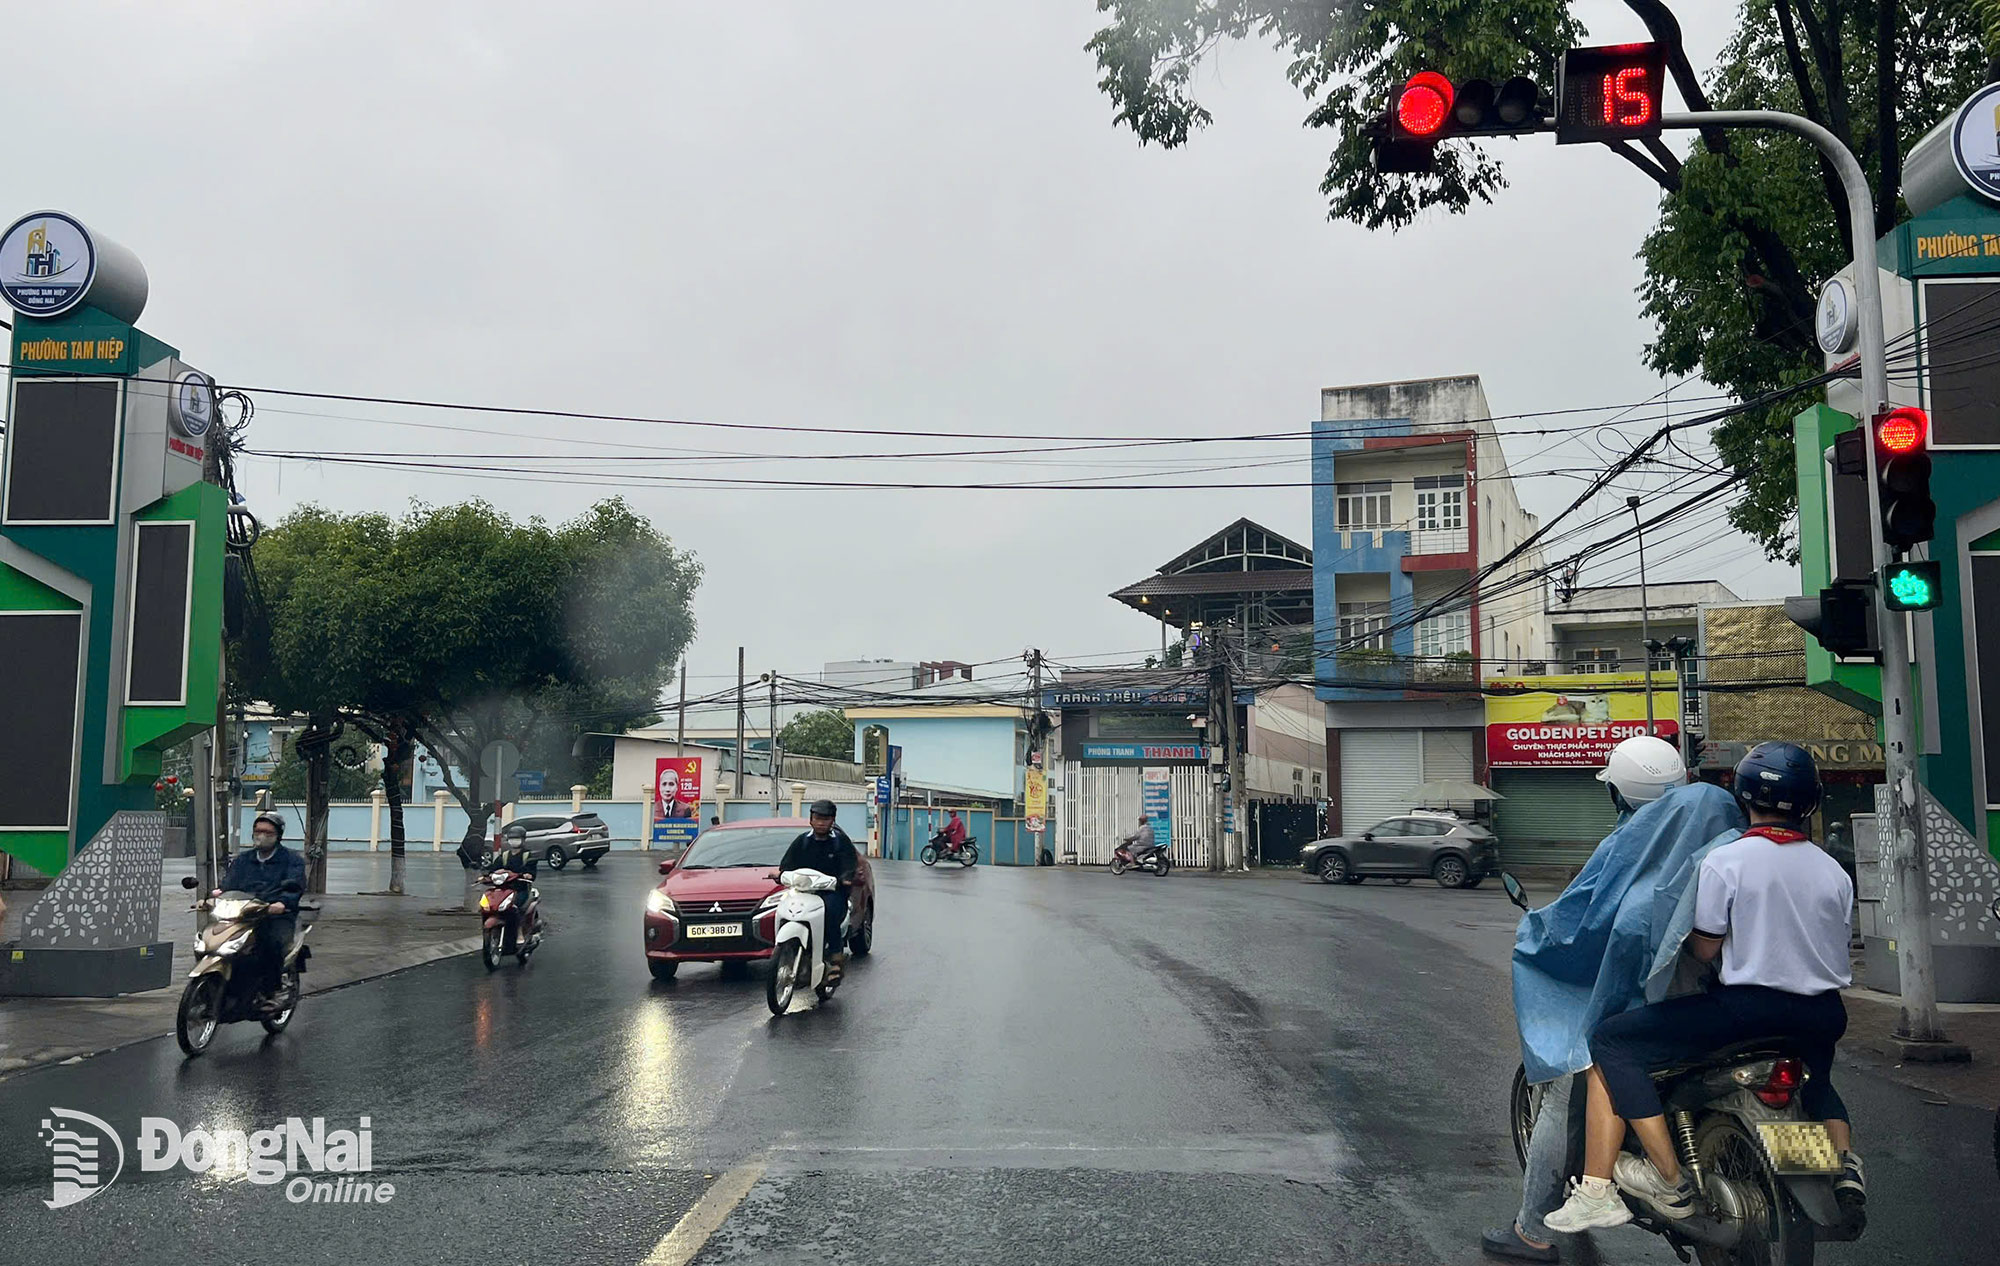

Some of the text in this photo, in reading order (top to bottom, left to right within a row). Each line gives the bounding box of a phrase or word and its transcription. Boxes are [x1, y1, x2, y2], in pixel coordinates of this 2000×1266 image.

[1603, 67, 1650, 126] 15
[1917, 230, 2000, 259] PHƯỜNG TA
[20, 336, 124, 364] PHƯỜNG TAM HIỆP
[1054, 693, 1101, 703] TRANH
[1104, 690, 1141, 703] THÊU
[1506, 727, 1575, 741] GOLDEN
[1576, 726, 1608, 739] PET
[1512, 741, 1546, 750] CHUYÊN:
[1546, 743, 1567, 751] THỰC
[1567, 740, 1590, 750] PHẨM
[1595, 742, 1612, 751] PHỤ
[1087, 746, 1111, 756] PHÒNG
[1112, 747, 1135, 756] TRANH
[1141, 746, 1196, 759] THANH
[1564, 751, 1581, 760] SẠN
[680, 782, 693, 790] 120
